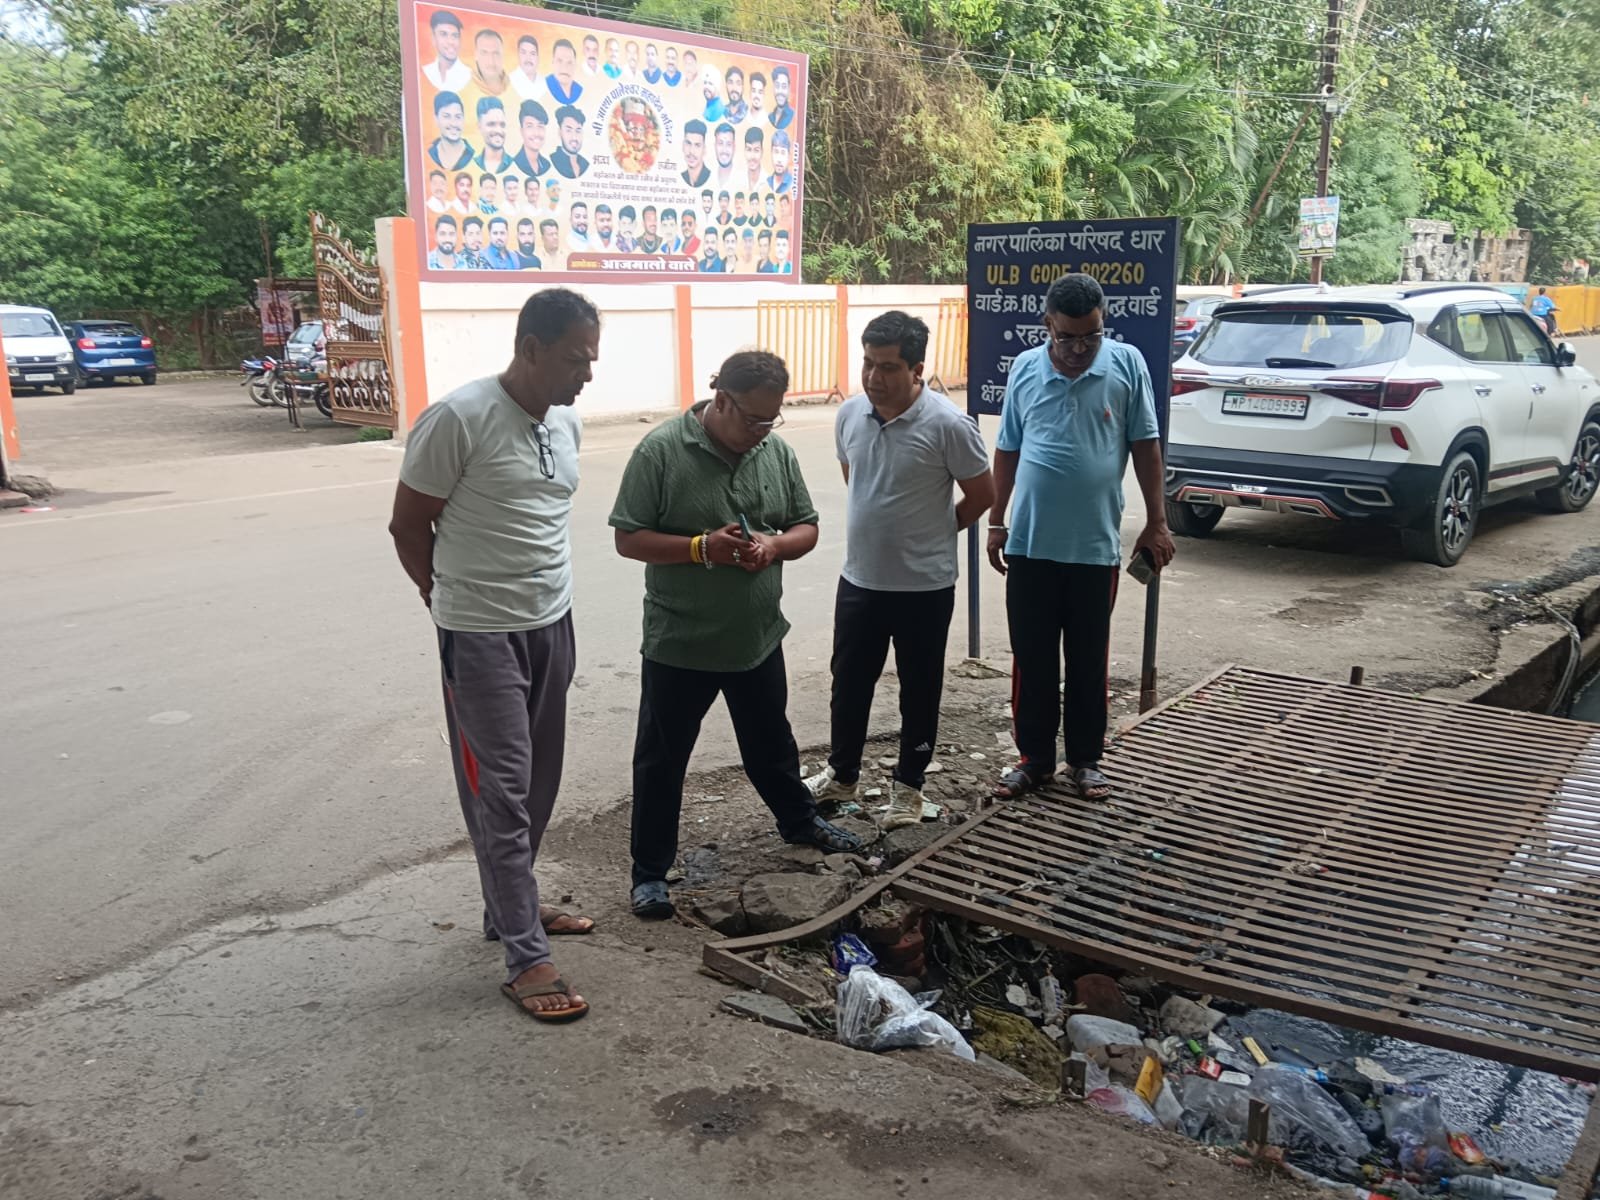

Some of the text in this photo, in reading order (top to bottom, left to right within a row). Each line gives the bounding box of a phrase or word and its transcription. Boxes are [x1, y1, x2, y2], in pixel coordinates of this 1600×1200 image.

[974, 224, 1166, 256] नगर पालिका परिषद धार
[986, 263, 1020, 286] ULB
[975, 287, 1003, 313] वार्ड
[1128, 286, 1162, 317] वार्ड
